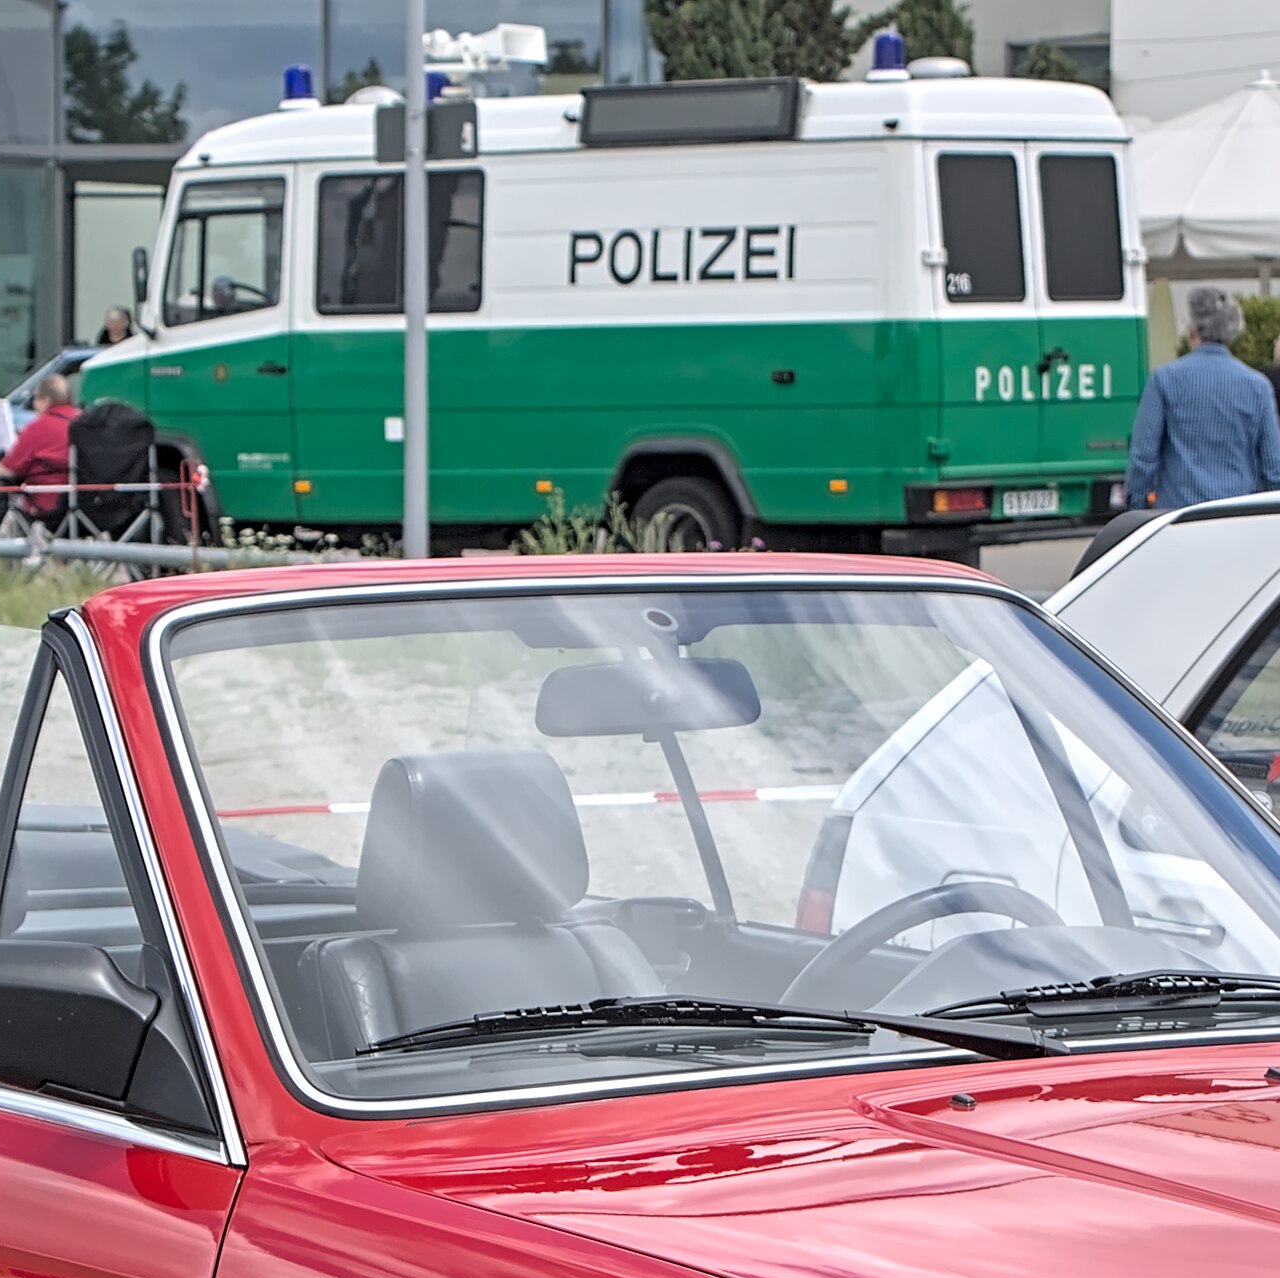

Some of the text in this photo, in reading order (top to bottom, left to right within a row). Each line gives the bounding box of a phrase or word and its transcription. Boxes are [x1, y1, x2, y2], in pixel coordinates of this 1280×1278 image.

[568, 224, 797, 285] POLIZEI
[946, 272, 972, 295] 216
[974, 363, 1112, 402] POLIZEI
